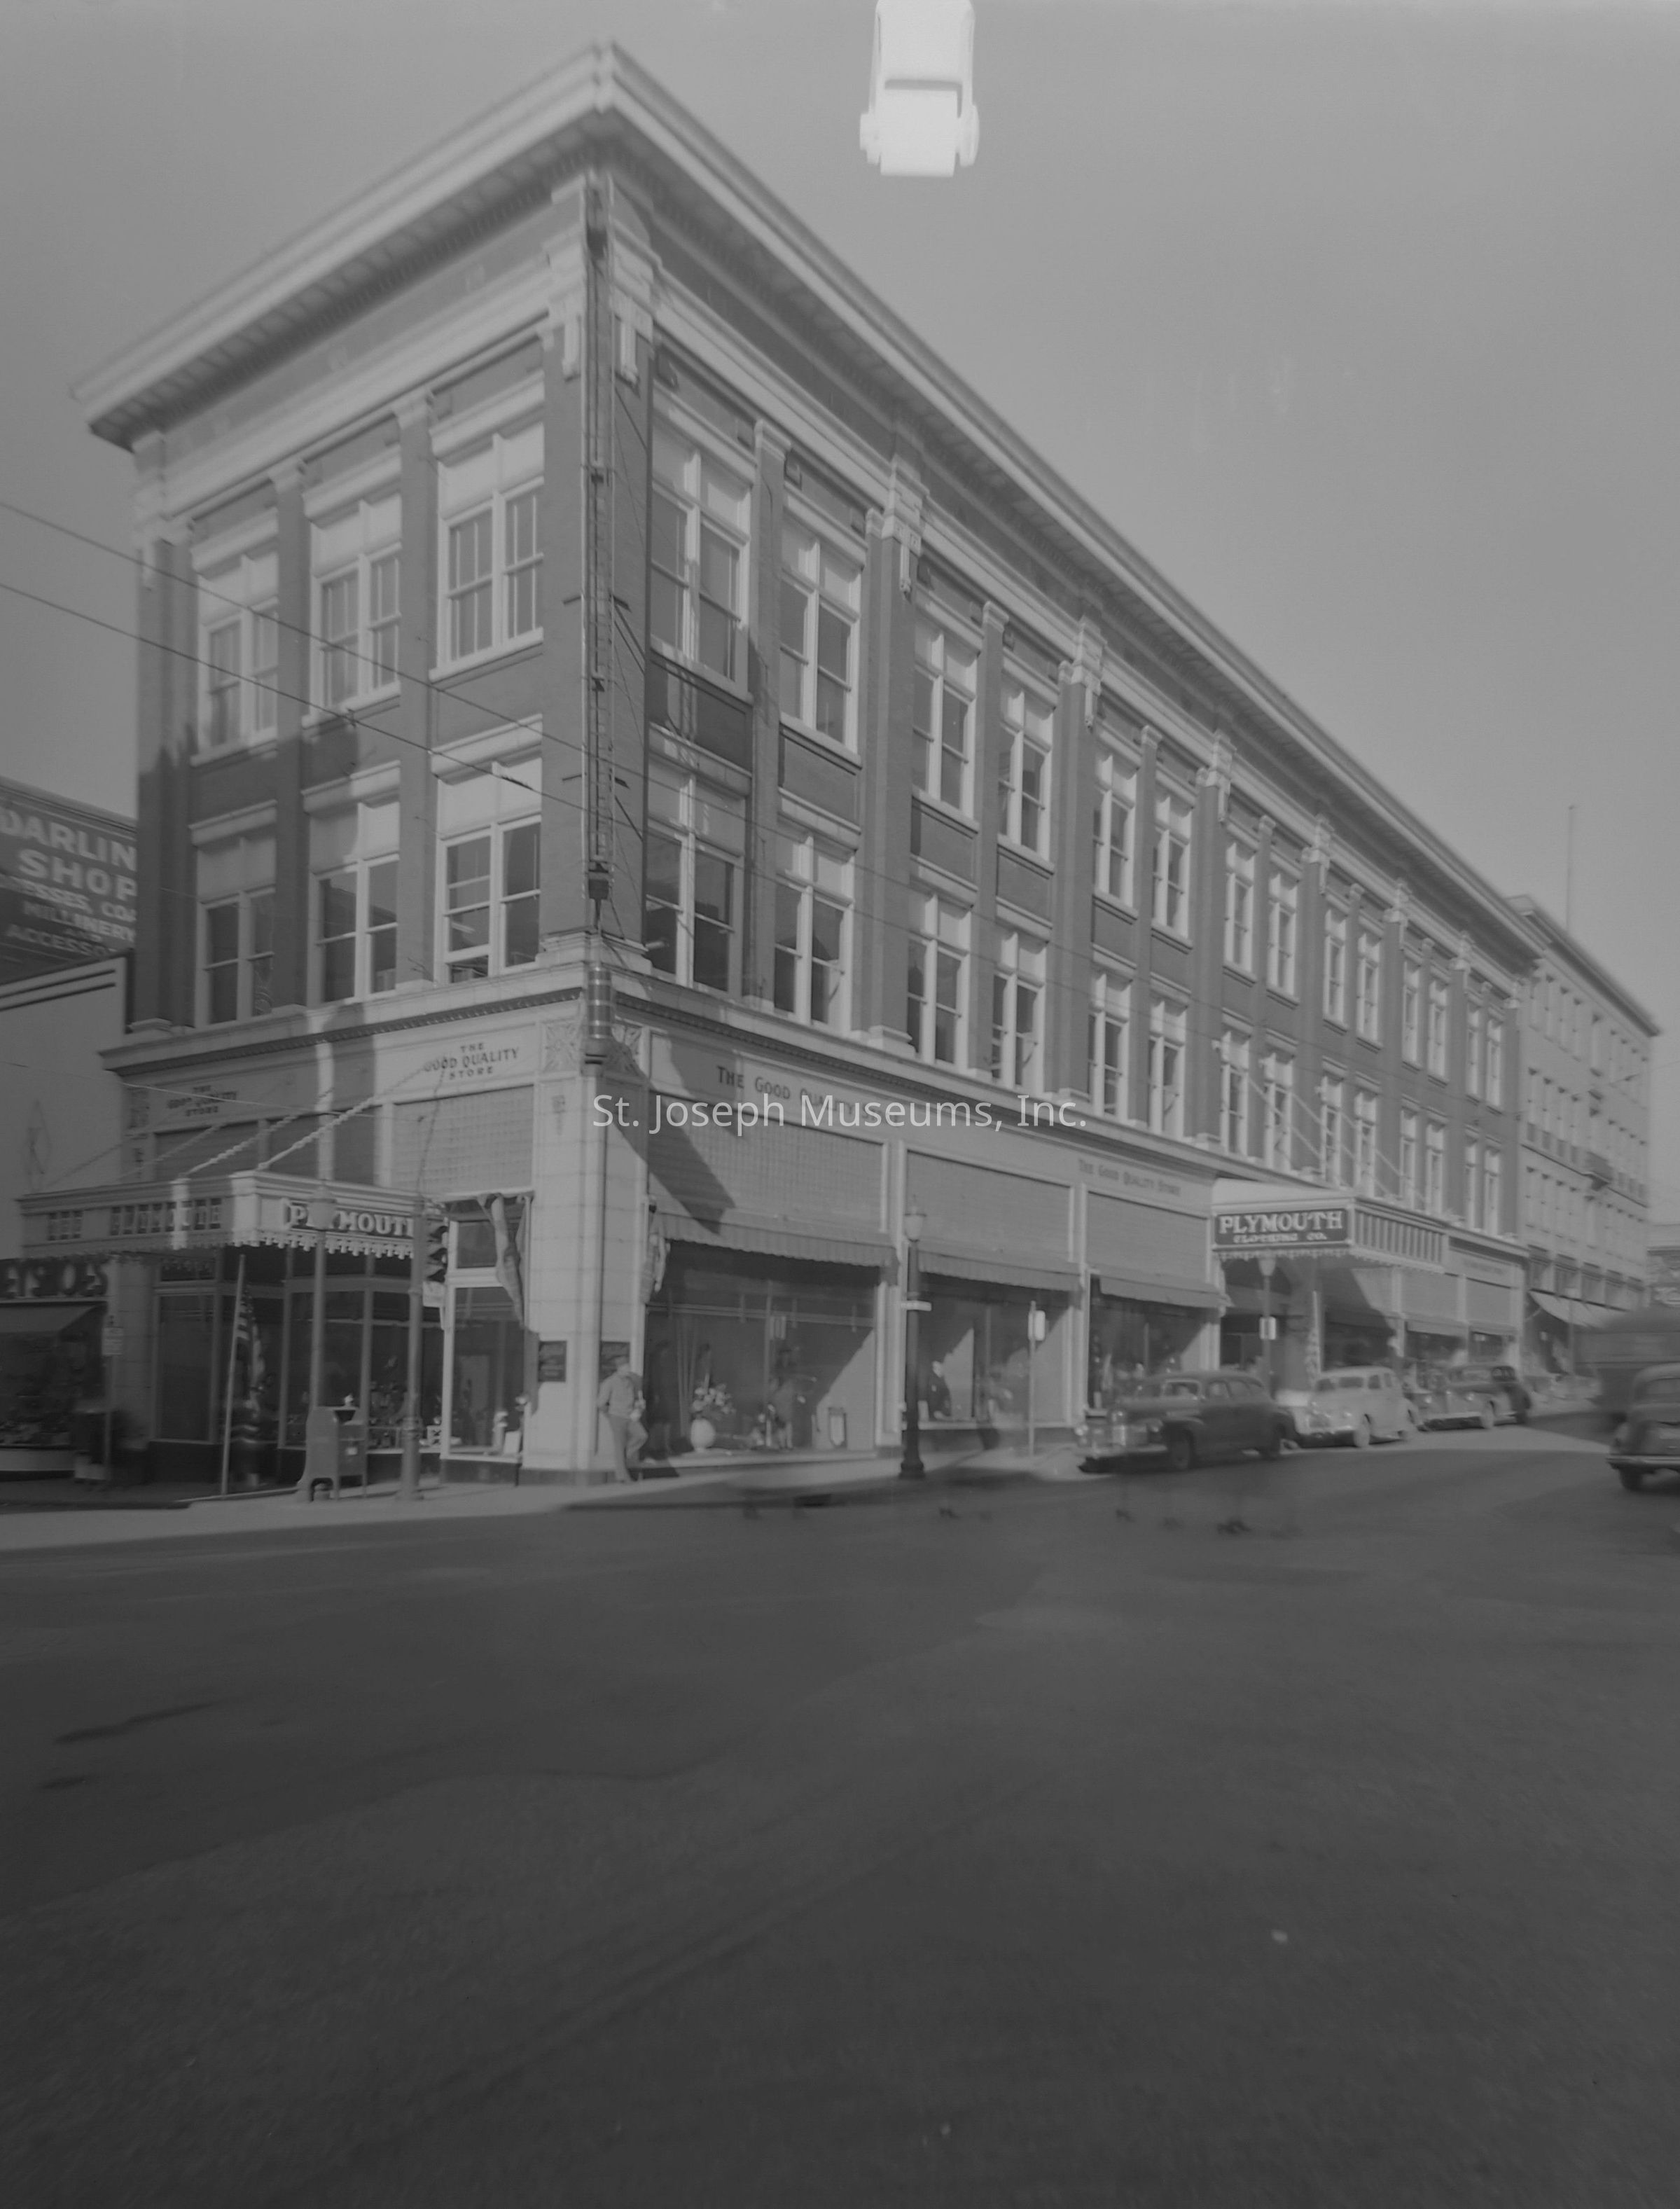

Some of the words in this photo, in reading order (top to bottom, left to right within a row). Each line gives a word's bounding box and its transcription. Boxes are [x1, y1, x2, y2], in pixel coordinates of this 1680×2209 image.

[18, 848, 137, 902] SHOP
[459, 1042, 484, 1053] THE
[462, 1046, 520, 1069] QUALITY
[717, 1065, 745, 1089] THE
[755, 1076, 791, 1100] GOOD
[1219, 1210, 1343, 1235] PLYMOUTH
